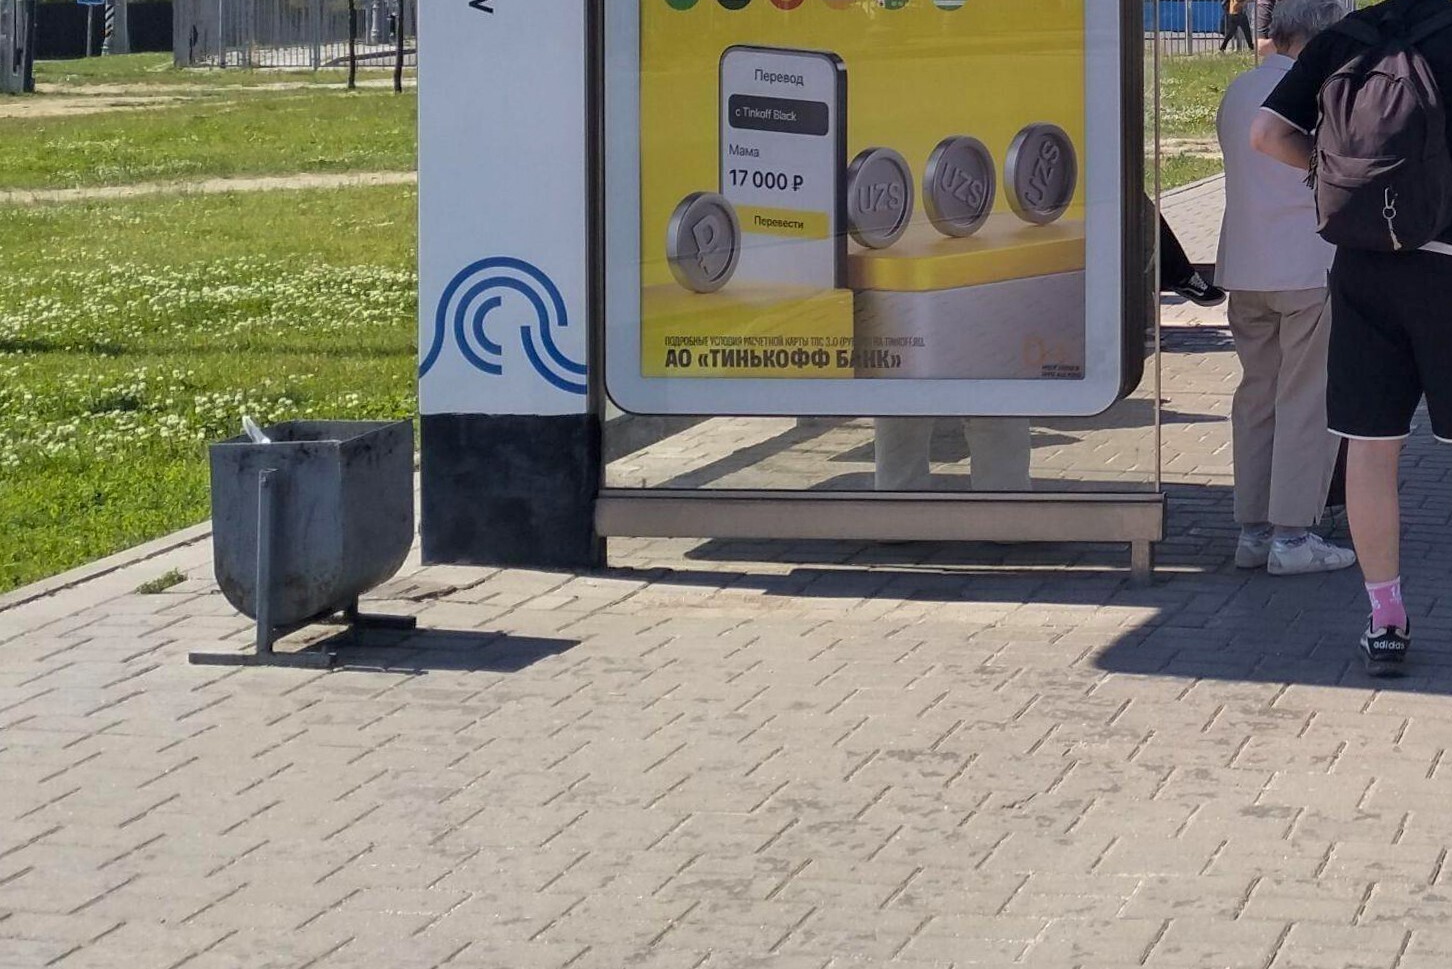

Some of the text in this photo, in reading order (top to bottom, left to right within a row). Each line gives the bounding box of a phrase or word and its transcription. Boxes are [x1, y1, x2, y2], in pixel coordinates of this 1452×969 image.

[753, 68, 805, 87] Перевод
[743, 106, 773, 120] Tinkoff
[773, 109, 798, 122] Black
[728, 143, 761, 158] Мама
[728, 168, 749, 187] 17
[752, 170, 788, 191] 000
[753, 215, 805, 230] Перевести
[665, 347, 902, 369] АО «ТИНЬКОФФ БАНК»
[1373, 639, 1406, 650] adidas
